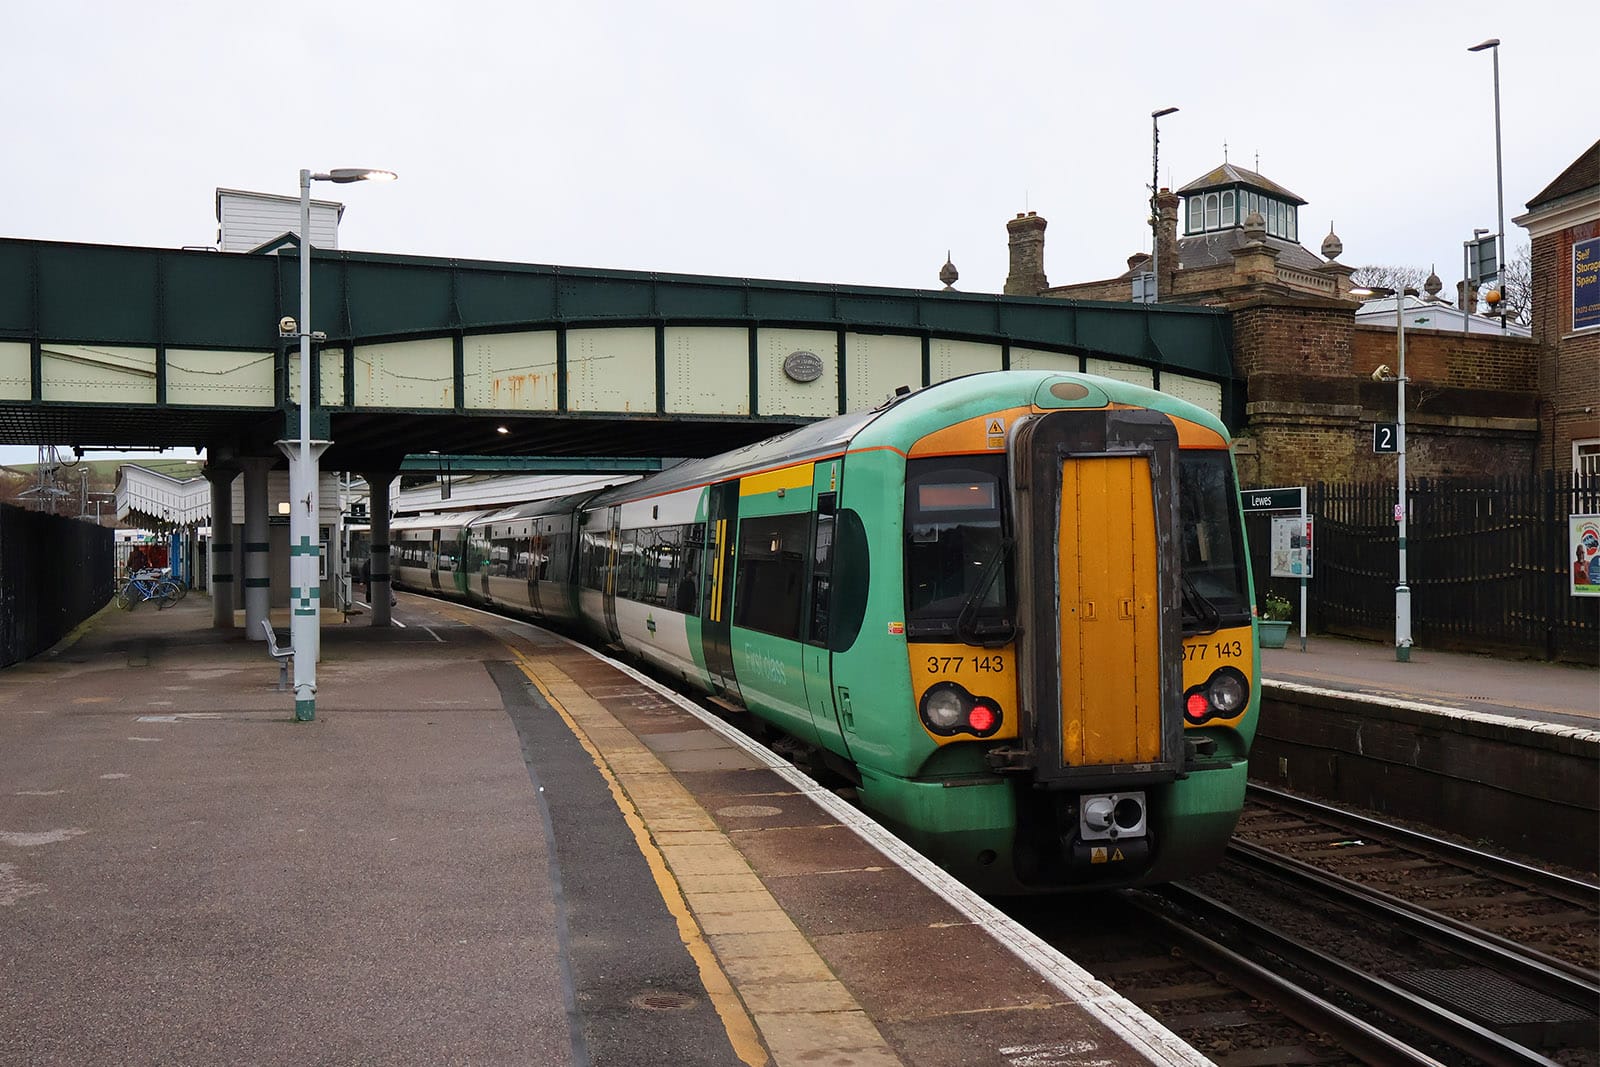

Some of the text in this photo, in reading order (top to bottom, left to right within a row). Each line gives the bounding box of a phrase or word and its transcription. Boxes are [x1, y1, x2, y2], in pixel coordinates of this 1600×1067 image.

[1576, 248, 1590, 261] Self
[1576, 274, 1597, 288] Space
[1381, 427, 1391, 449] 2
[1251, 495, 1272, 507] Lewes
[355, 506, 361, 516] 1
[1214, 640, 1242, 659] 143
[927, 655, 1004, 674] 377 143
